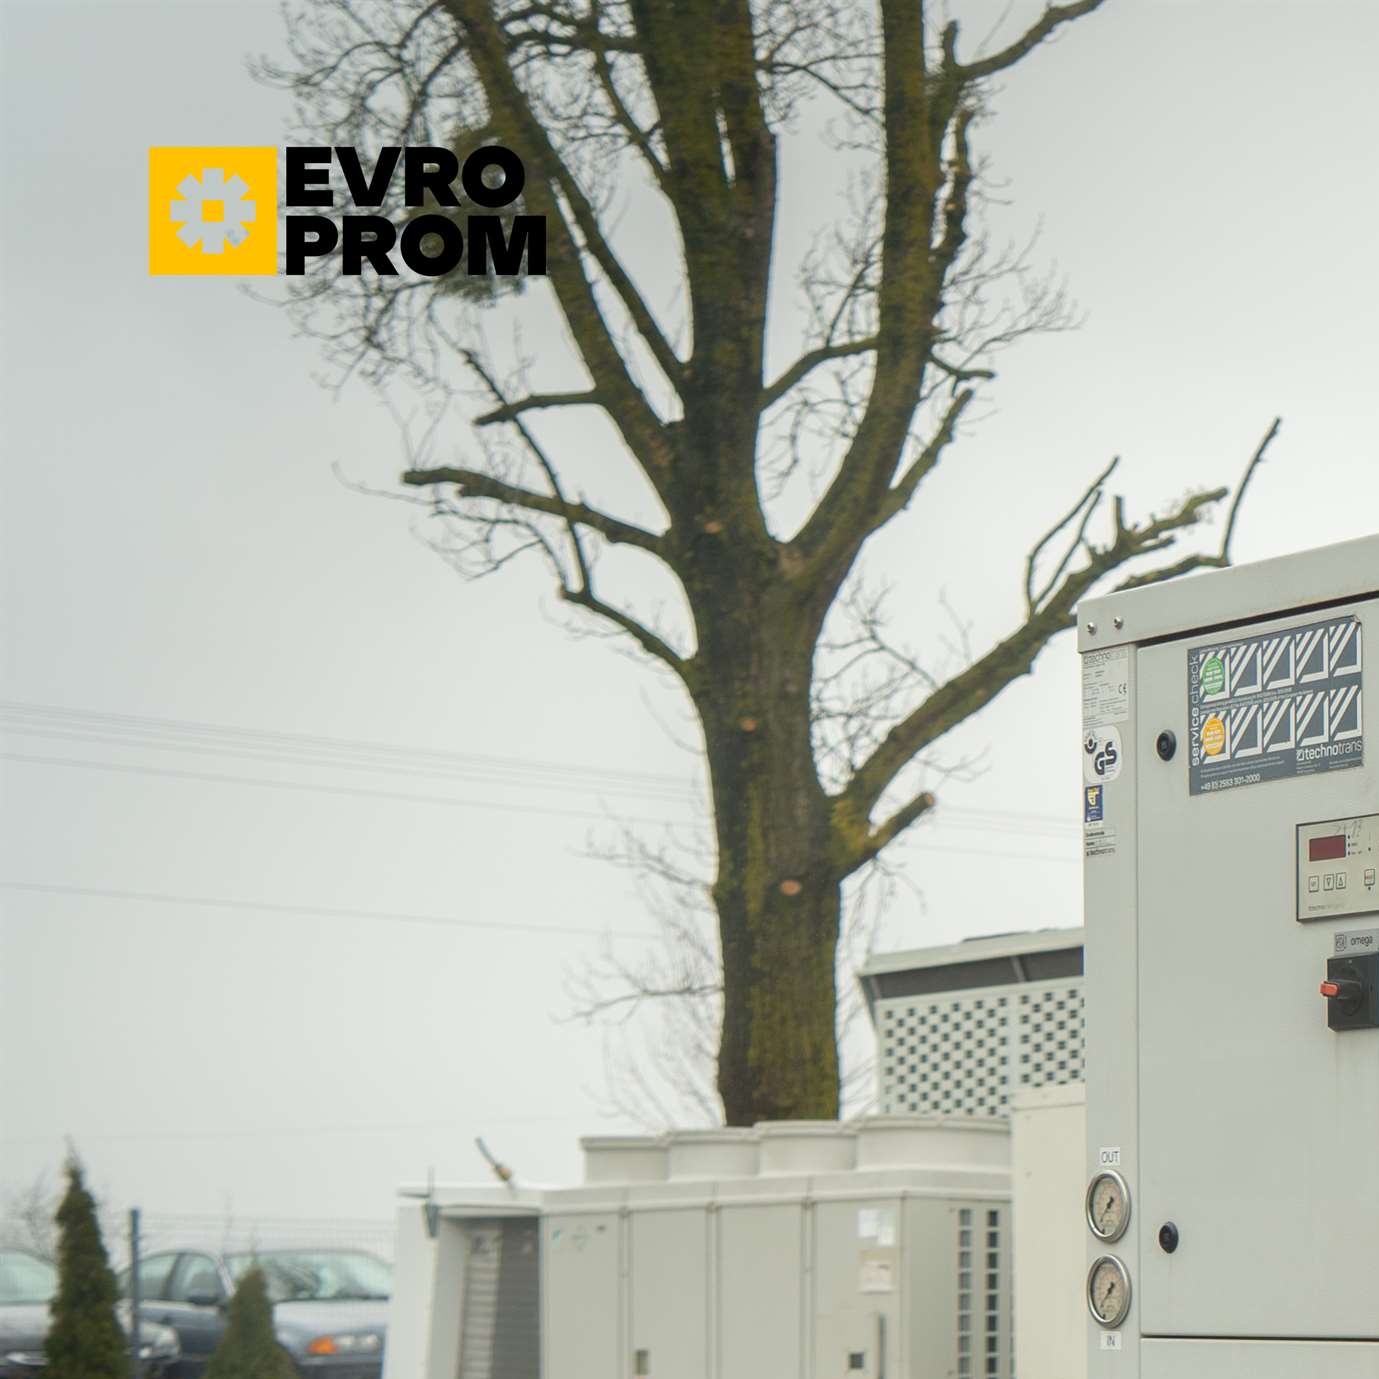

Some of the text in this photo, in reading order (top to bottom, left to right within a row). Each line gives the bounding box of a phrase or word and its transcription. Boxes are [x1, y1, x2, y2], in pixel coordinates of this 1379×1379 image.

[1305, 739, 1362, 761] technotrans
[1350, 935, 1373, 947] omega
[1101, 1151, 1119, 1163] OUT
[1107, 1336, 1116, 1347] IN
